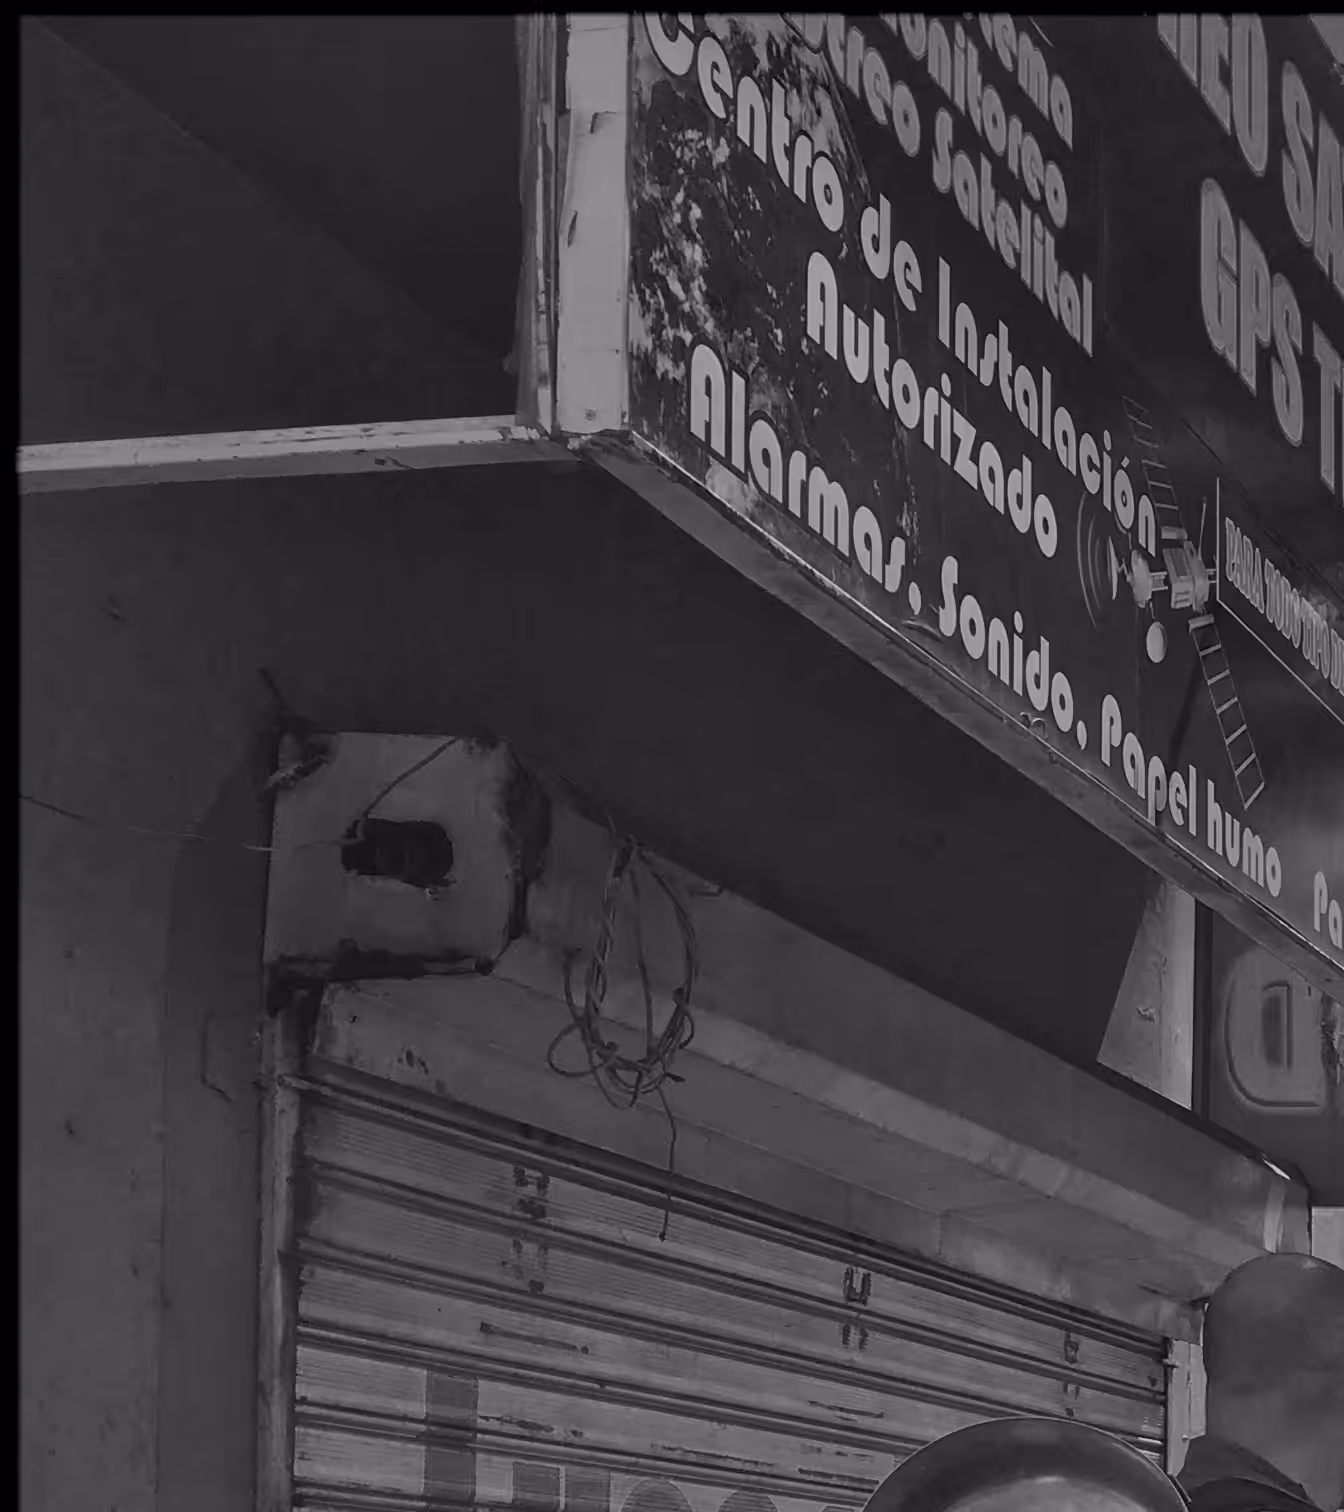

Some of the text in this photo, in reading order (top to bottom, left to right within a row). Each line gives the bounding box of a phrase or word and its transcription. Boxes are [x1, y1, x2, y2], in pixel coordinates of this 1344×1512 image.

[782, 13, 1094, 358] treo Satelital
[879, 13, 1068, 229] onitoreo
[643, 14, 1157, 557] Centro de Instalación
[805, 251, 1058, 559] Autorizado
[1200, 177, 1303, 447] GPS
[1225, 516, 1265, 615] PARA
[1264, 557, 1302, 649] TODO
[1101, 693, 1199, 828] Papel
[1206, 779, 1283, 898] humo
